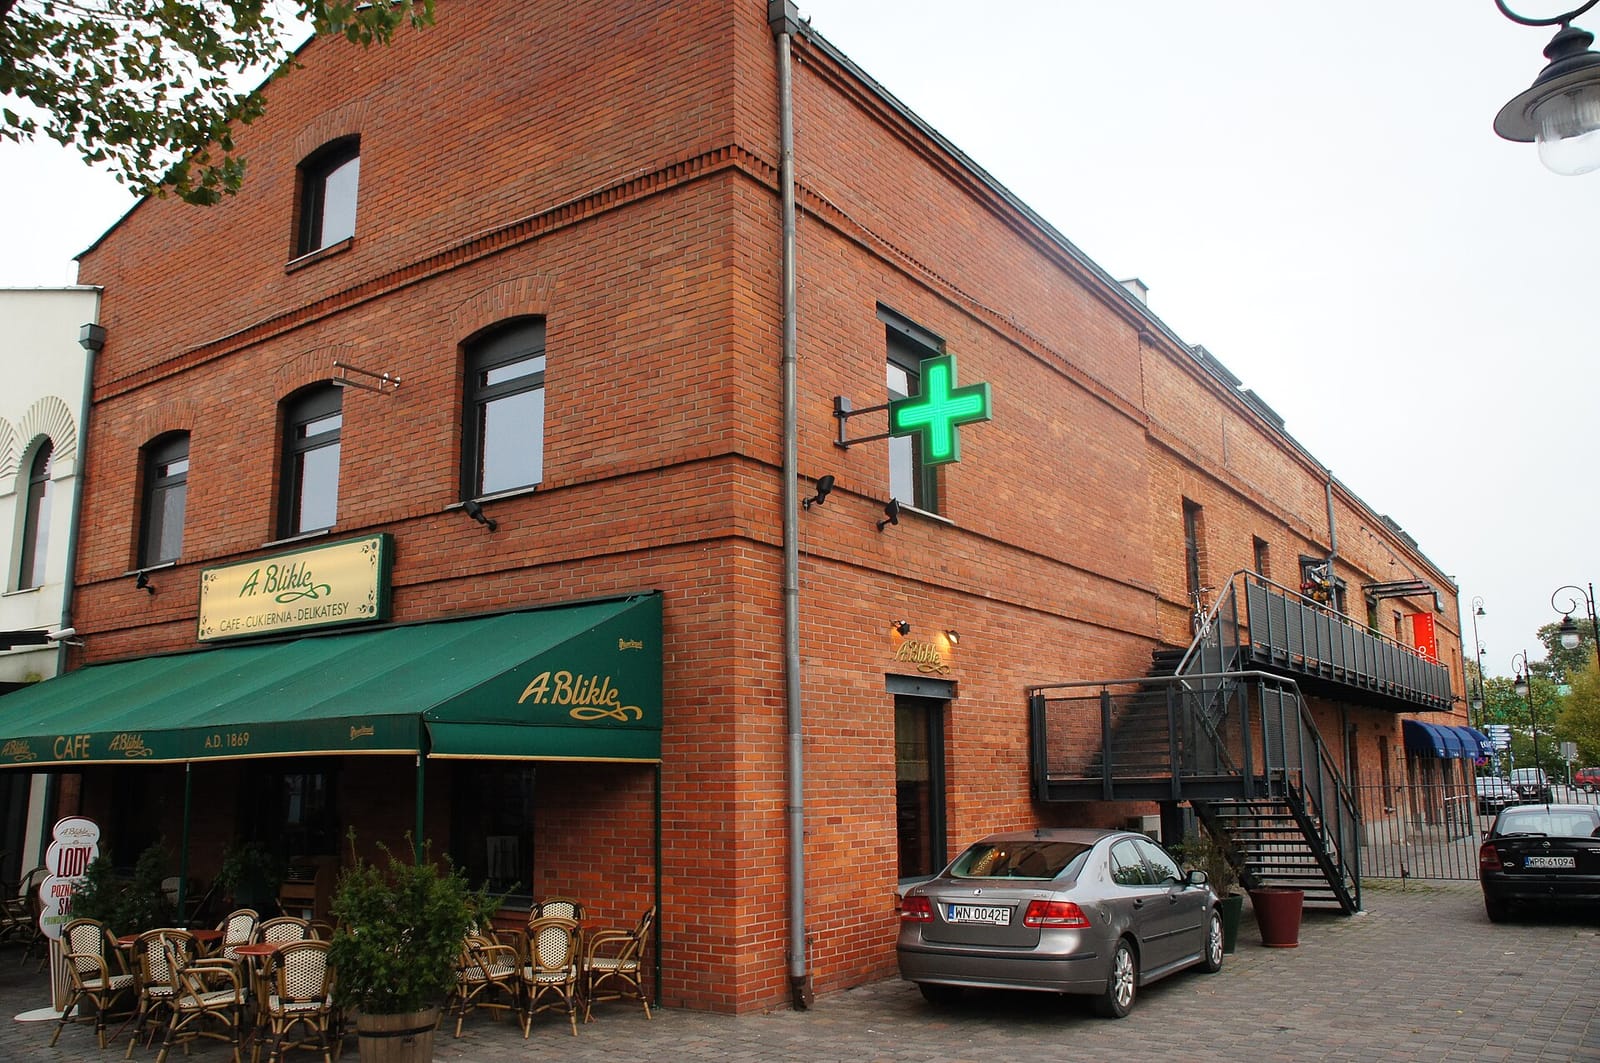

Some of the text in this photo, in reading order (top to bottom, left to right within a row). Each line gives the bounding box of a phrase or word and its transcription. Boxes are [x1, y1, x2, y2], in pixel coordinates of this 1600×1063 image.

[263, 561, 331, 603] Blikle
[220, 602, 349, 632] CAFE CUKIERNIA DELIKATESY
[551, 670, 643, 722] Blikle
[53, 734, 91, 760] CAFE
[204, 731, 250, 749] A.D. 1869
[56, 846, 92, 878] LODY
[1528, 857, 1574, 866] WPR 61094
[955, 906, 970, 919] WN
[974, 908, 1009, 921] 0042E
